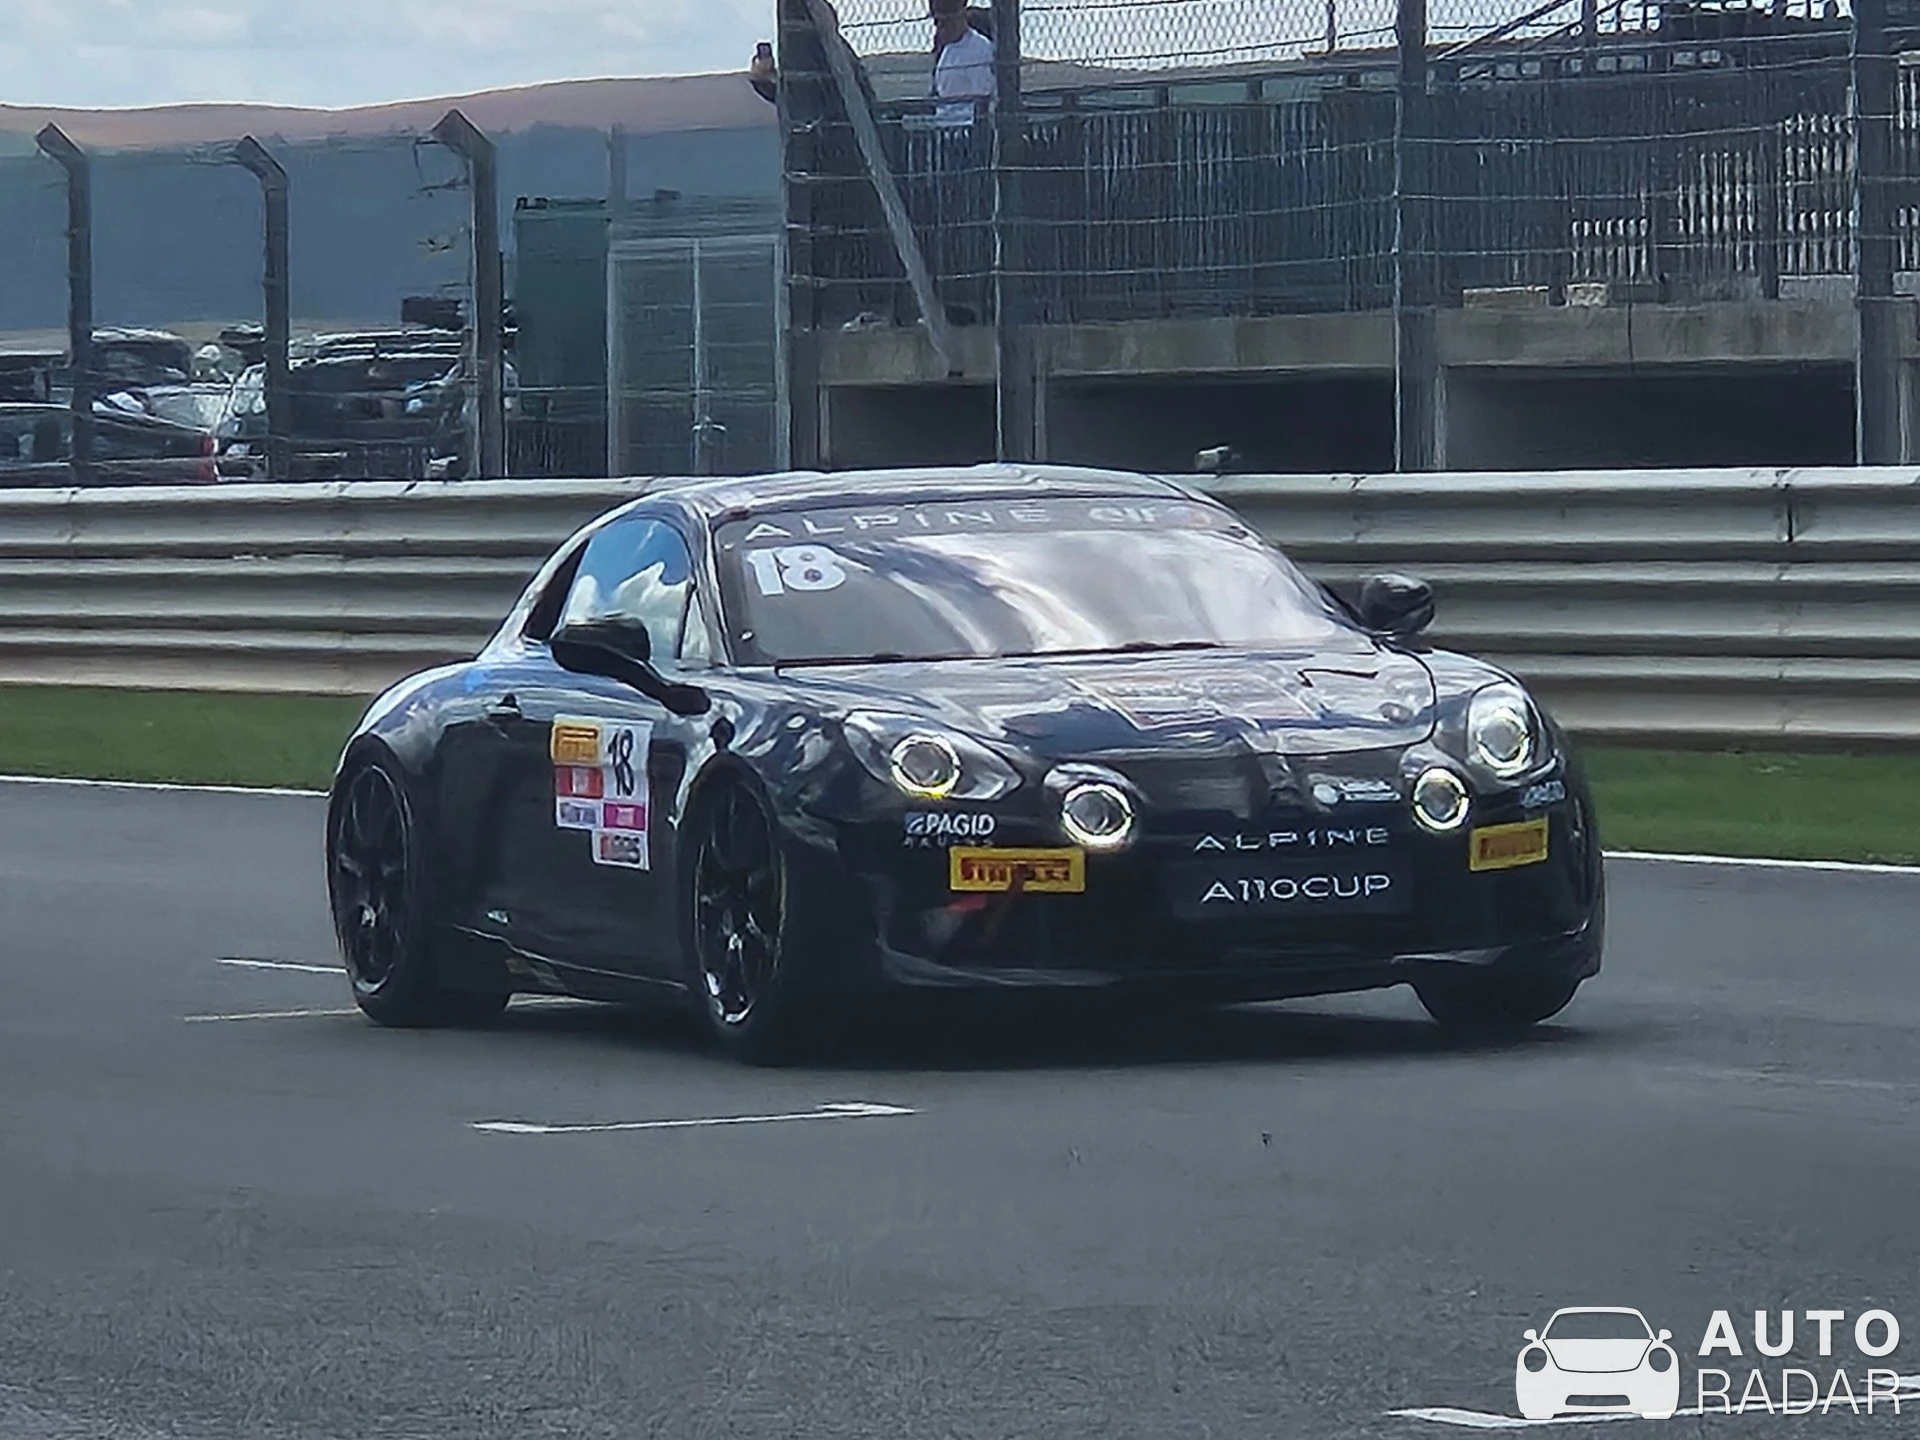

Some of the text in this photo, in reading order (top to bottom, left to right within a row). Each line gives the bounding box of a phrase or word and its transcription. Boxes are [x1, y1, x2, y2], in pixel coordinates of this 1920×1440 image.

[745, 507, 1050, 541] ALPINE
[747, 545, 846, 596] 18
[607, 729, 635, 797] 18
[925, 813, 995, 836] PAGID
[1194, 827, 1389, 851] ALPINE
[1201, 874, 1391, 903] A110CUP
